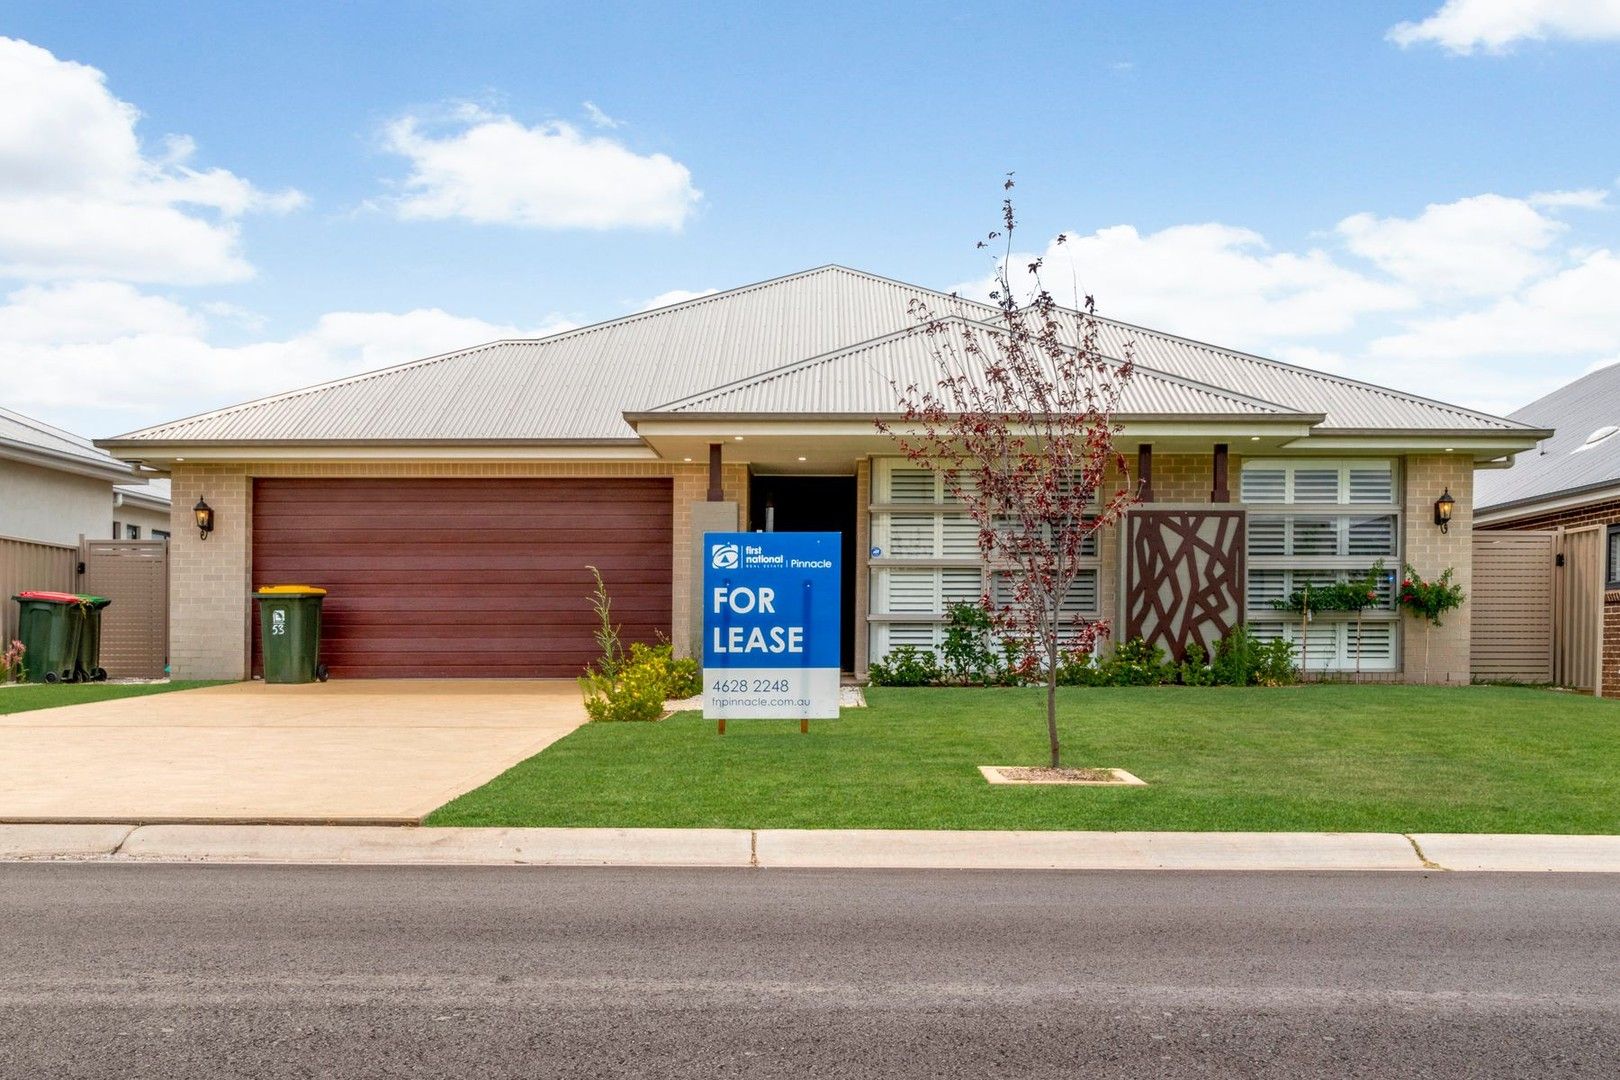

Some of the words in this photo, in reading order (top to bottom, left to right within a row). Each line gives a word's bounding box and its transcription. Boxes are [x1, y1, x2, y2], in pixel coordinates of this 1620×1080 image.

[745, 546, 762, 555] first
[745, 555, 784, 564] national
[791, 559, 832, 569] Pinnacle
[714, 587, 775, 614] FOR
[272, 624, 285, 635] 53
[714, 626, 803, 653] LEASE
[712, 679, 748, 693] 4628
[753, 679, 789, 693] 2248
[712, 697, 811, 707] fnpinnacle.com.au
